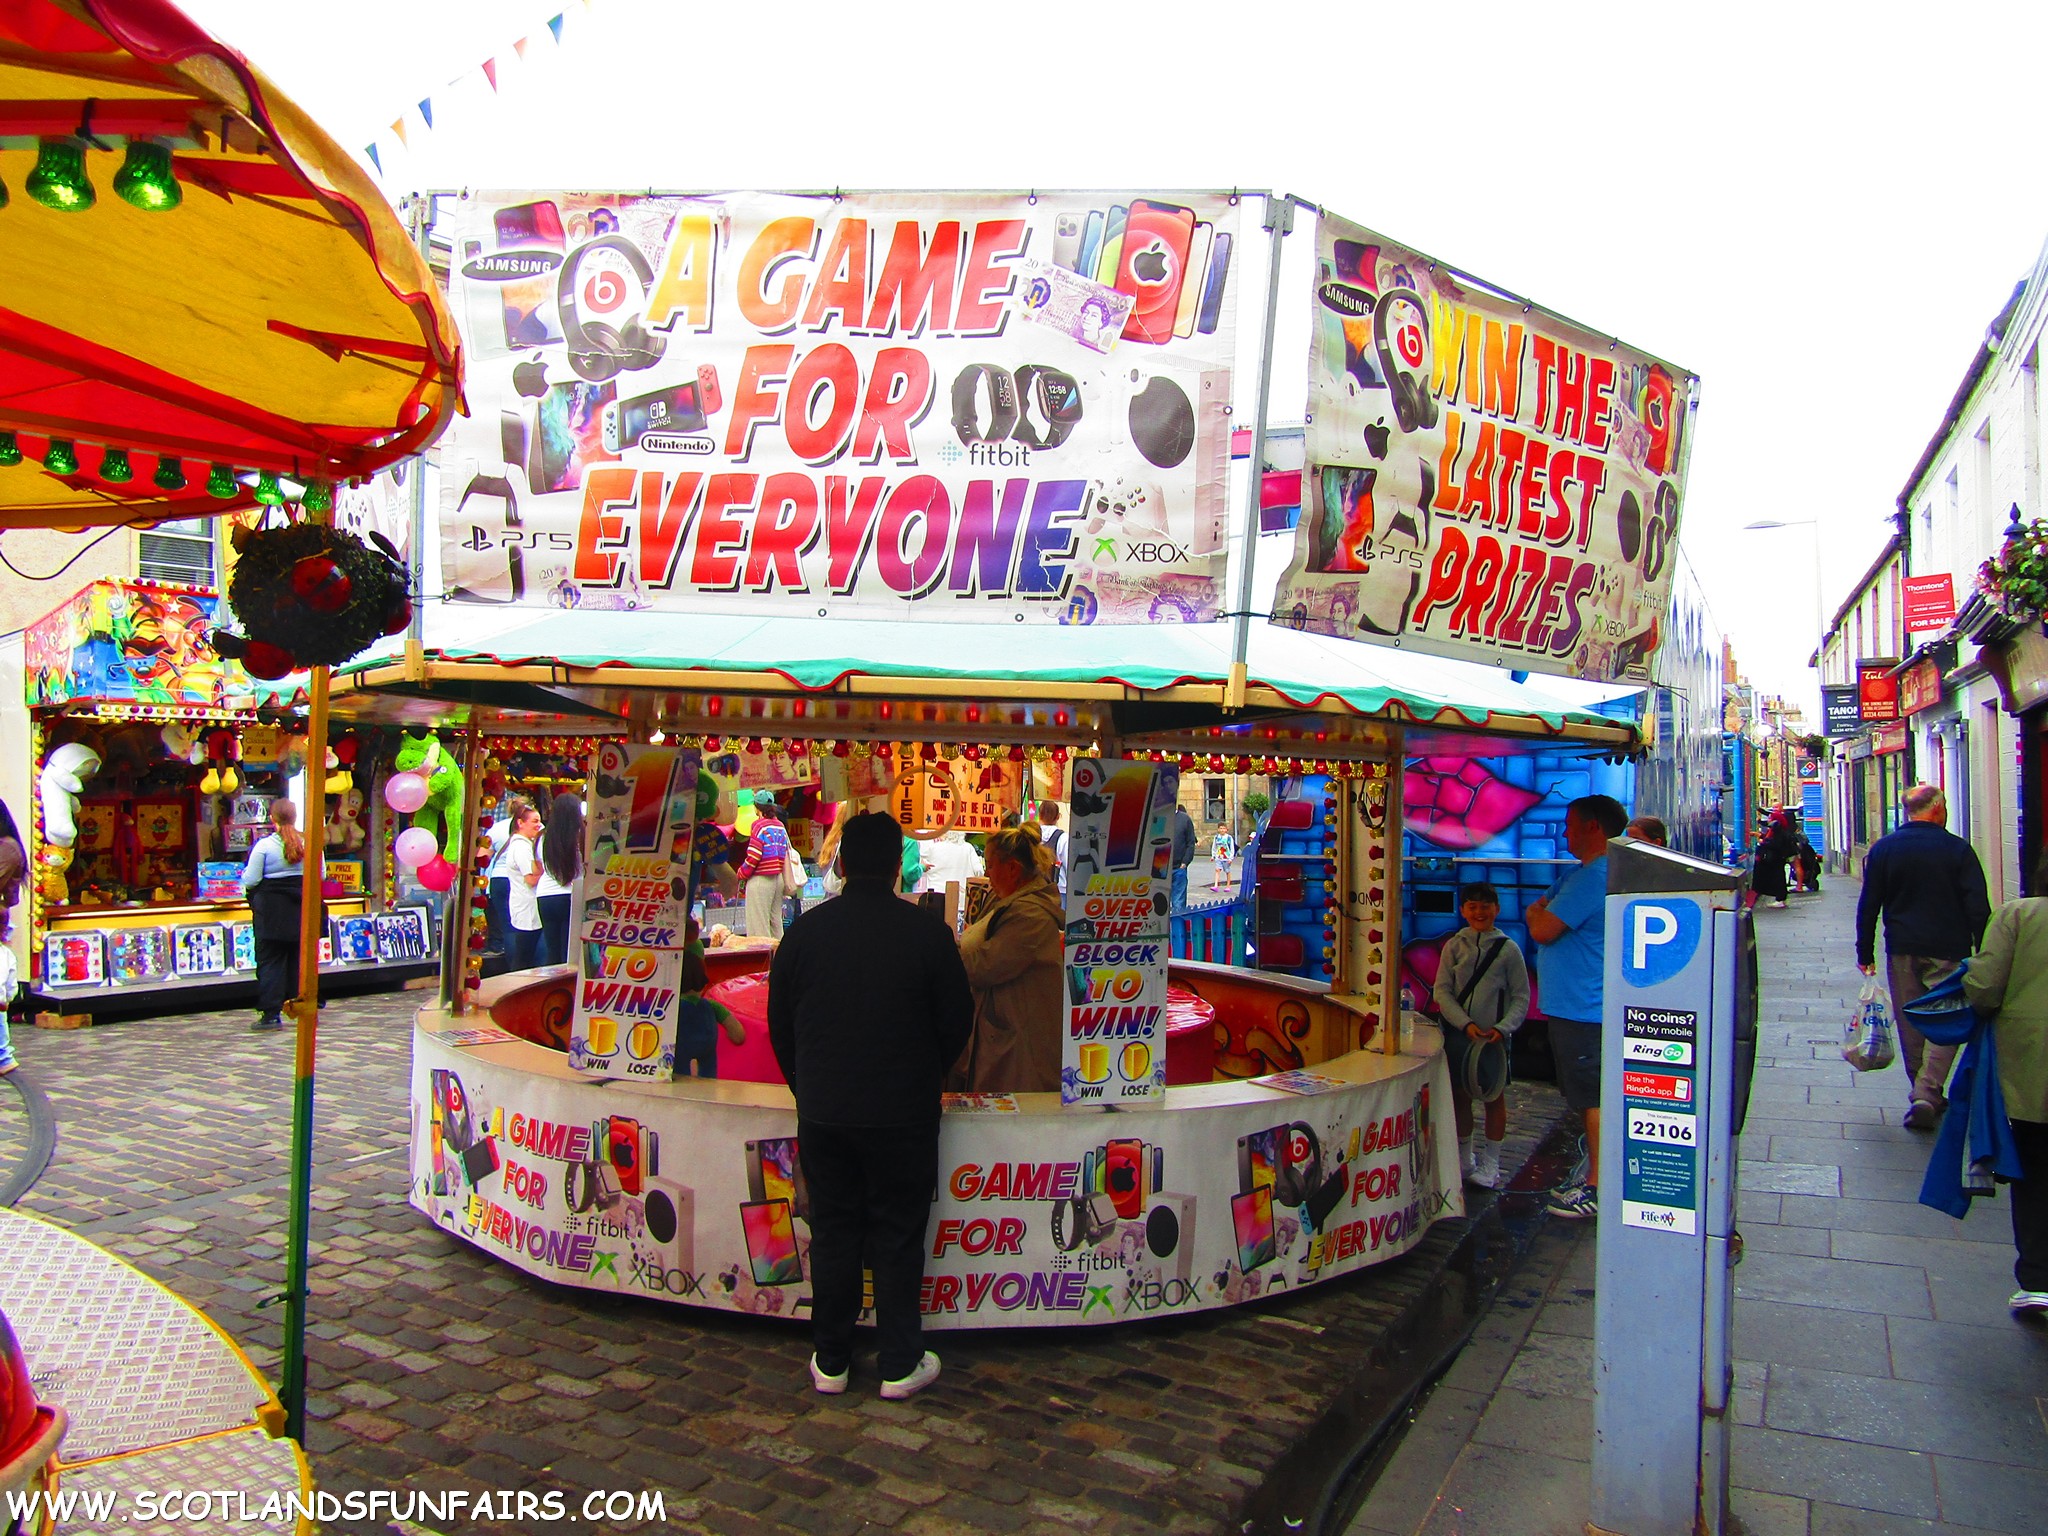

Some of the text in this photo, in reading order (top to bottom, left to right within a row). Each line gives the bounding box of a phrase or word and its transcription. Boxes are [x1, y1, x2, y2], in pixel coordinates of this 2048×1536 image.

[475, 258, 552, 273] SAMSUNG
[646, 214, 1036, 338] A GAME
[1325, 284, 1370, 316] SAMSUNG
[998, 376, 1011, 389] 12
[1430, 290, 1618, 454] WIN THE
[724, 343, 934, 468] FOR
[1000, 390, 1012, 404] 58
[648, 438, 709, 452] Nintendo
[970, 443, 1030, 467] fitbit
[1433, 412, 1609, 553] LATEST
[501, 531, 573, 550] PS5
[572, 467, 1097, 600] EVERYONE
[1126, 543, 1190, 563] XBOX
[1381, 544, 1424, 569] PS5
[1412, 526, 1597, 658] PRIZES
[1906, 583, 1945, 592] Thorntons
[1643, 590, 1662, 611] fitbit
[1604, 619, 1628, 638] XBOX
[1911, 619, 1928, 628] FOR
[933, 799, 946, 811] RING
[971, 802, 978, 814] BE
[936, 814, 944, 826] ON
[970, 816, 977, 827] TO
[981, 817, 992, 828] WIN
[606, 854, 671, 880] RING
[604, 877, 671, 903] OVER
[1086, 873, 1152, 897] RING
[611, 900, 660, 925] THE
[1084, 898, 1153, 921] OVER
[590, 921, 676, 947] BLOCK
[1093, 921, 1144, 942] THE
[1633, 905, 1678, 969] P
[604, 945, 658, 982] TO
[1073, 944, 1159, 967] BLOCK
[1090, 969, 1144, 1003] TO
[582, 980, 675, 1021] WIN!
[1070, 1005, 1162, 1040] WIN!
[1627, 1009, 1695, 1025] No coins?
[1627, 1023, 1693, 1037] Pay by mobile
[1633, 1043, 1683, 1060] RingGo
[586, 1057, 657, 1076] WIN LOSE
[1626, 1075, 1641, 1083] Use
[1080, 1085, 1150, 1098] WIN LOSE
[1626, 1085, 1656, 1094] RingGo
[489, 1106, 506, 1143] A
[509, 1112, 591, 1164] GAME
[1345, 1126, 1361, 1163] A
[1362, 1107, 1417, 1155] GAME
[1633, 1121, 1692, 1140] 22106
[503, 1160, 548, 1211] FOR
[948, 1161, 1081, 1201] GAME
[1351, 1163, 1401, 1208] FOR
[586, 1214, 634, 1241] fitbit
[1641, 1211, 1660, 1222] Fife
[468, 1194, 597, 1274] EVERYONE
[932, 1217, 1027, 1258] FOR
[1307, 1199, 1421, 1272] EVERYONE
[1078, 1251, 1127, 1273] fitbit
[629, 1258, 707, 1299] XBOX
[1123, 1276, 1202, 1315] XBOX
